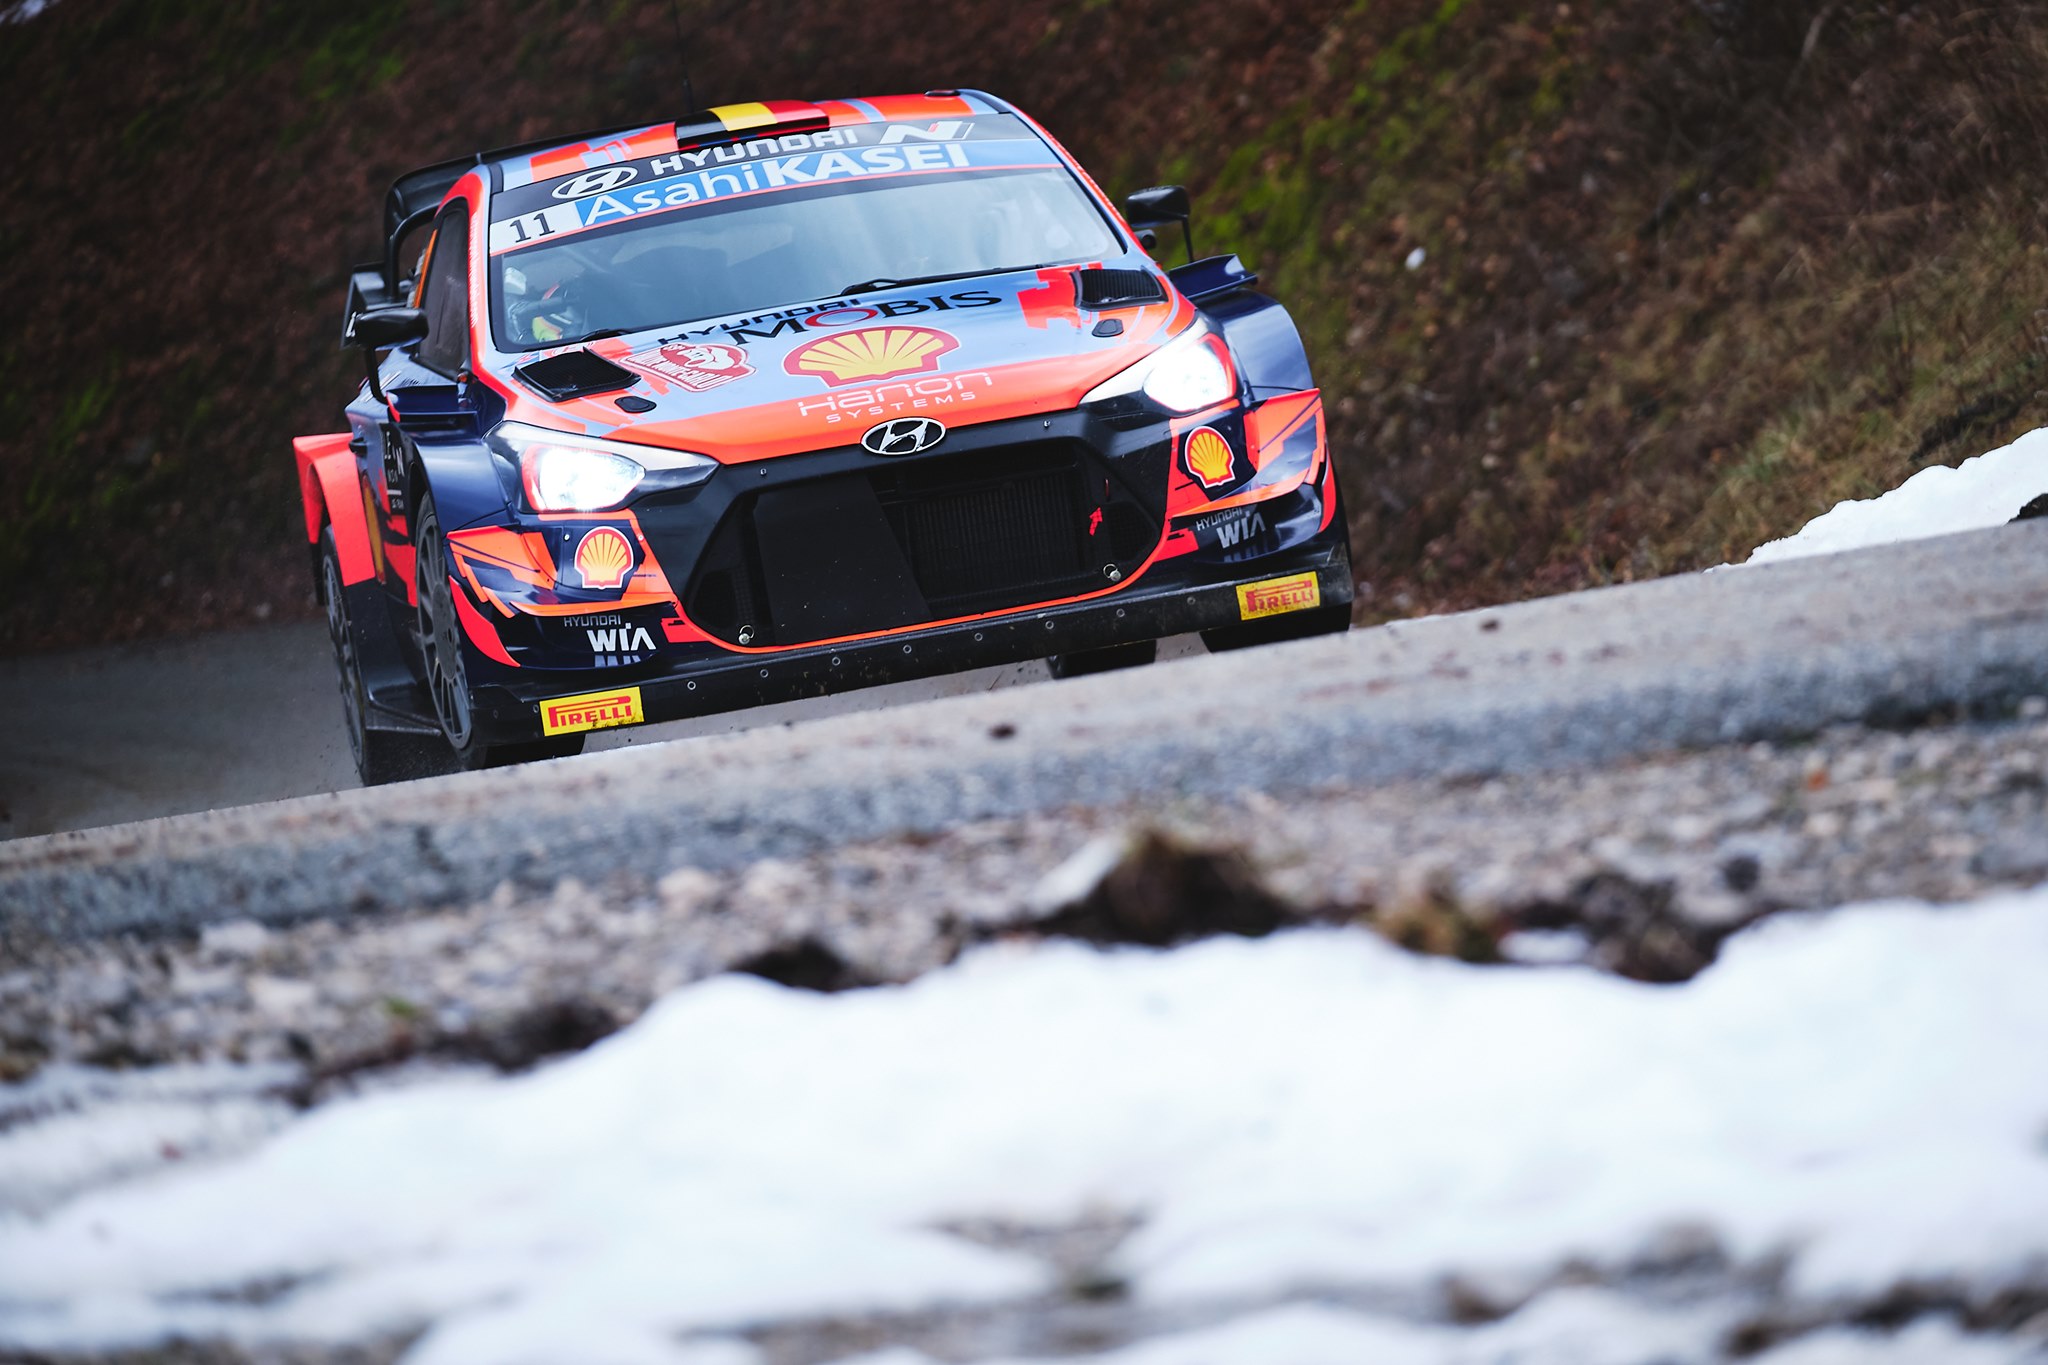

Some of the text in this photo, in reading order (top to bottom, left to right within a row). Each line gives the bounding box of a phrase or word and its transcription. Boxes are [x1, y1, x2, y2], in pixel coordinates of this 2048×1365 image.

[650, 129, 858, 176] HYUNDAI
[510, 212, 556, 243] 11
[657, 298, 862, 345] HYUNDAI
[726, 290, 1003, 346] MOBIS
[826, 391, 976, 423] SYSTEMS
[1195, 506, 1243, 531] HYUNDAI
[1246, 580, 1313, 612] PIRELLI
[563, 614, 621, 627] HYUNDAI
[548, 695, 632, 728] PIRELLI
